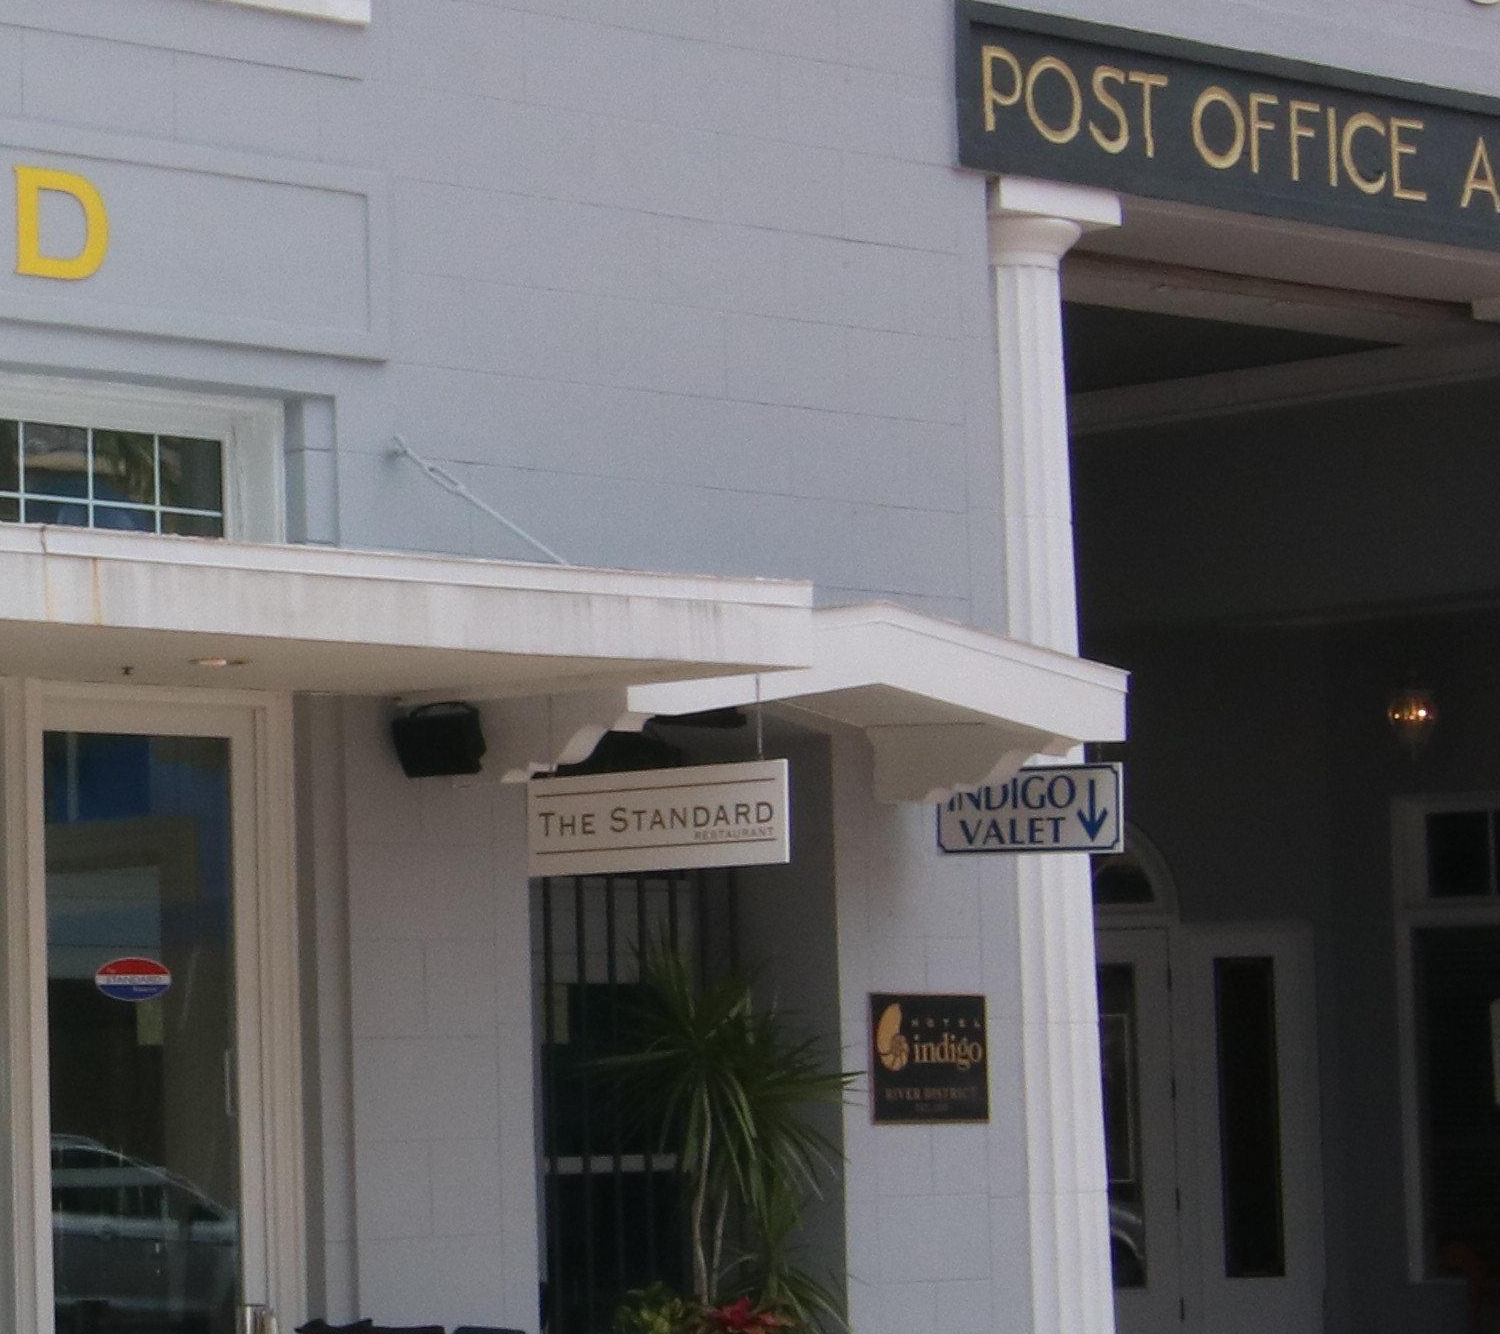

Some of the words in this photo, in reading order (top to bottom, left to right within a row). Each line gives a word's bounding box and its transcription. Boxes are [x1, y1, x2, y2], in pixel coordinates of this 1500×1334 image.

[979, 44, 1168, 159] POST
[1191, 85, 1428, 203] OFFICE
[958, 816, 1067, 846] VALET
[912, 1032, 983, 1071] indigo
